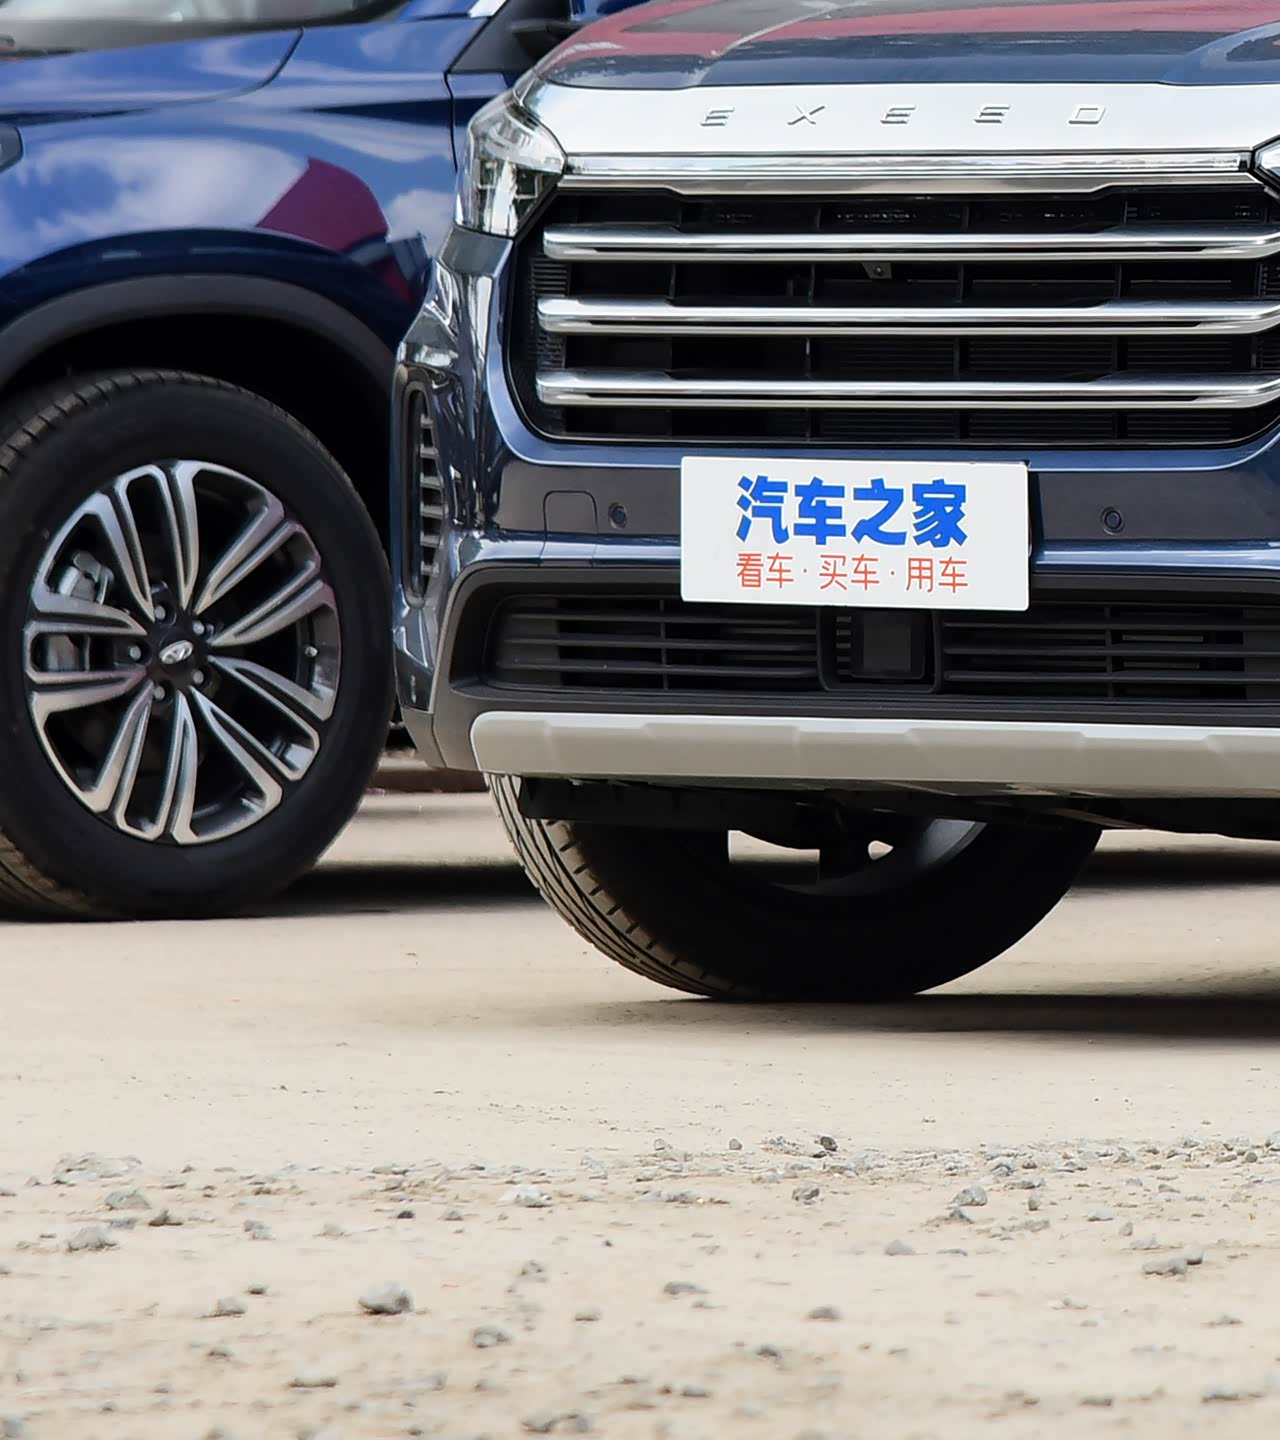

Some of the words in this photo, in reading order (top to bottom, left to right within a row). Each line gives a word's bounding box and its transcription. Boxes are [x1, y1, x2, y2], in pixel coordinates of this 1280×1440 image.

[699, 104, 1107, 127] EXEED
[736, 475, 968, 548] 汽车之家
